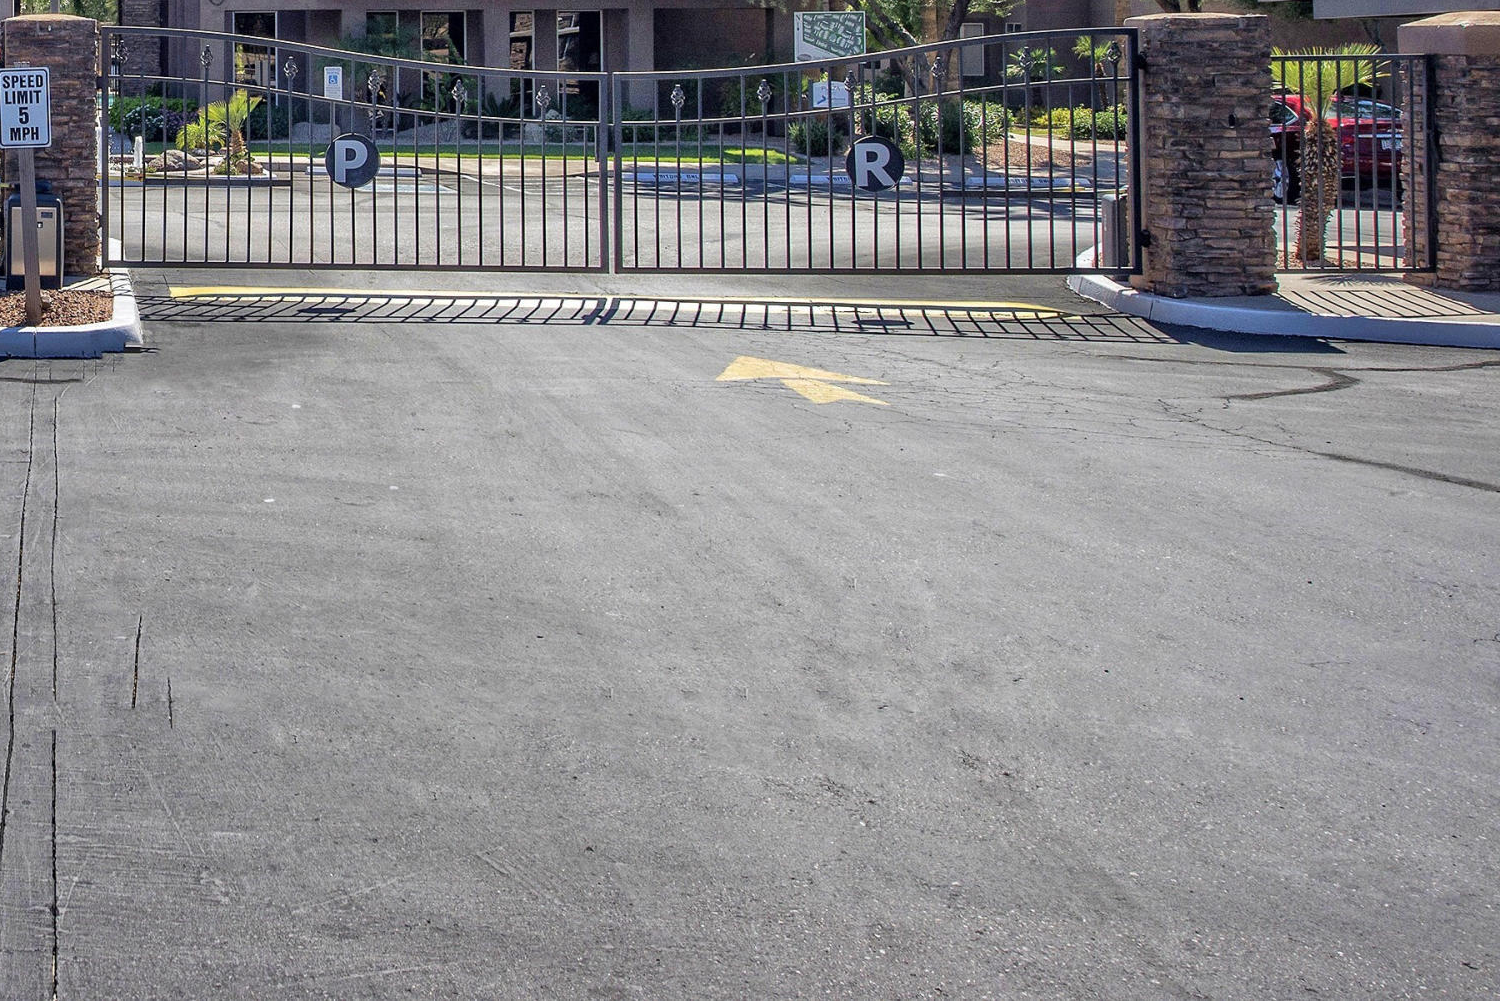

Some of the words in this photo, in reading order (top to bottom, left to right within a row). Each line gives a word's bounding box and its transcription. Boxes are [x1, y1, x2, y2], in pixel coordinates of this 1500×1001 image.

[2, 75, 44, 89] SPEED
[4, 90, 42, 105] LIMIT
[18, 107, 30, 125] 5
[10, 127, 40, 141] MPH
[334, 139, 368, 183] P
[854, 142, 896, 187] R
